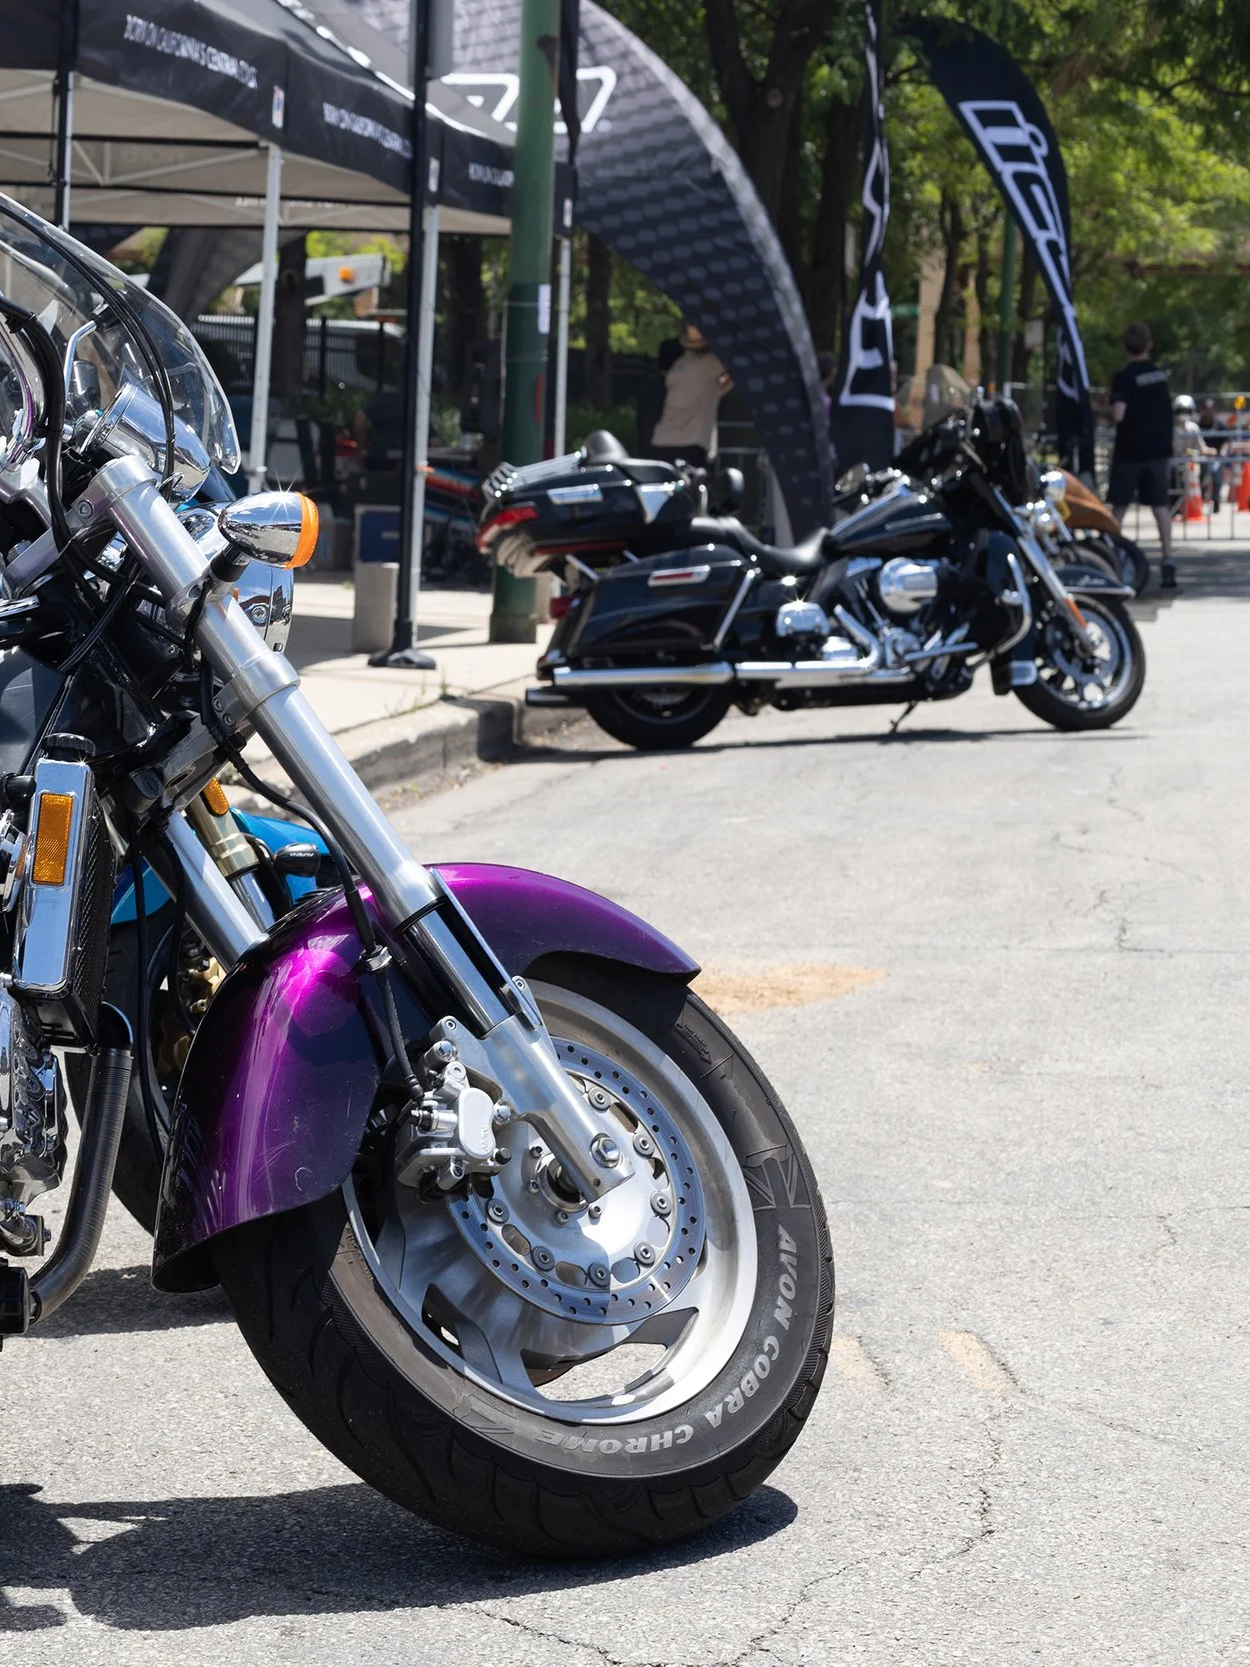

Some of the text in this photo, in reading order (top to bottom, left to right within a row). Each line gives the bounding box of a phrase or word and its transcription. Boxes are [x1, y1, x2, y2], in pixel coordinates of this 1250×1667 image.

[534, 1223, 797, 1456] AVON COBRA CHROME
